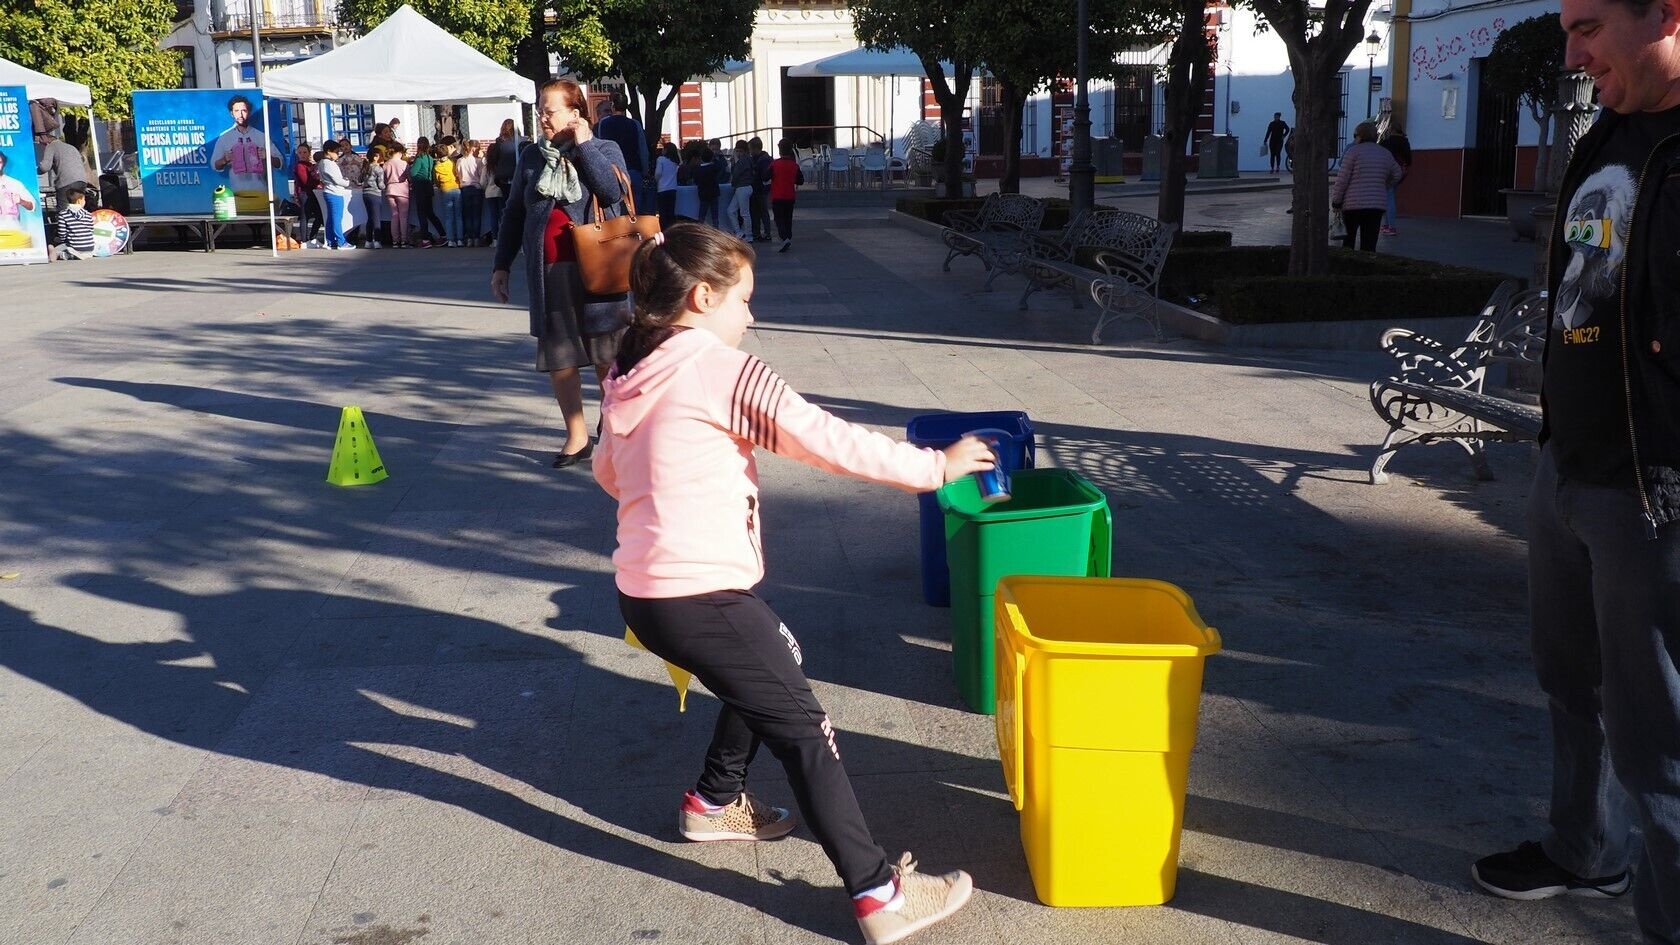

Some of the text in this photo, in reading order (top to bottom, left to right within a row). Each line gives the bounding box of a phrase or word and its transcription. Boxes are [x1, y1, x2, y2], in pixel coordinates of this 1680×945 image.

[141, 133, 171, 145] PIENSA
[172, 132, 190, 145] CON
[143, 147, 207, 165] PULMONES
[156, 171, 200, 185] RECICLA
[1563, 327, 1599, 344] E=MC2?
